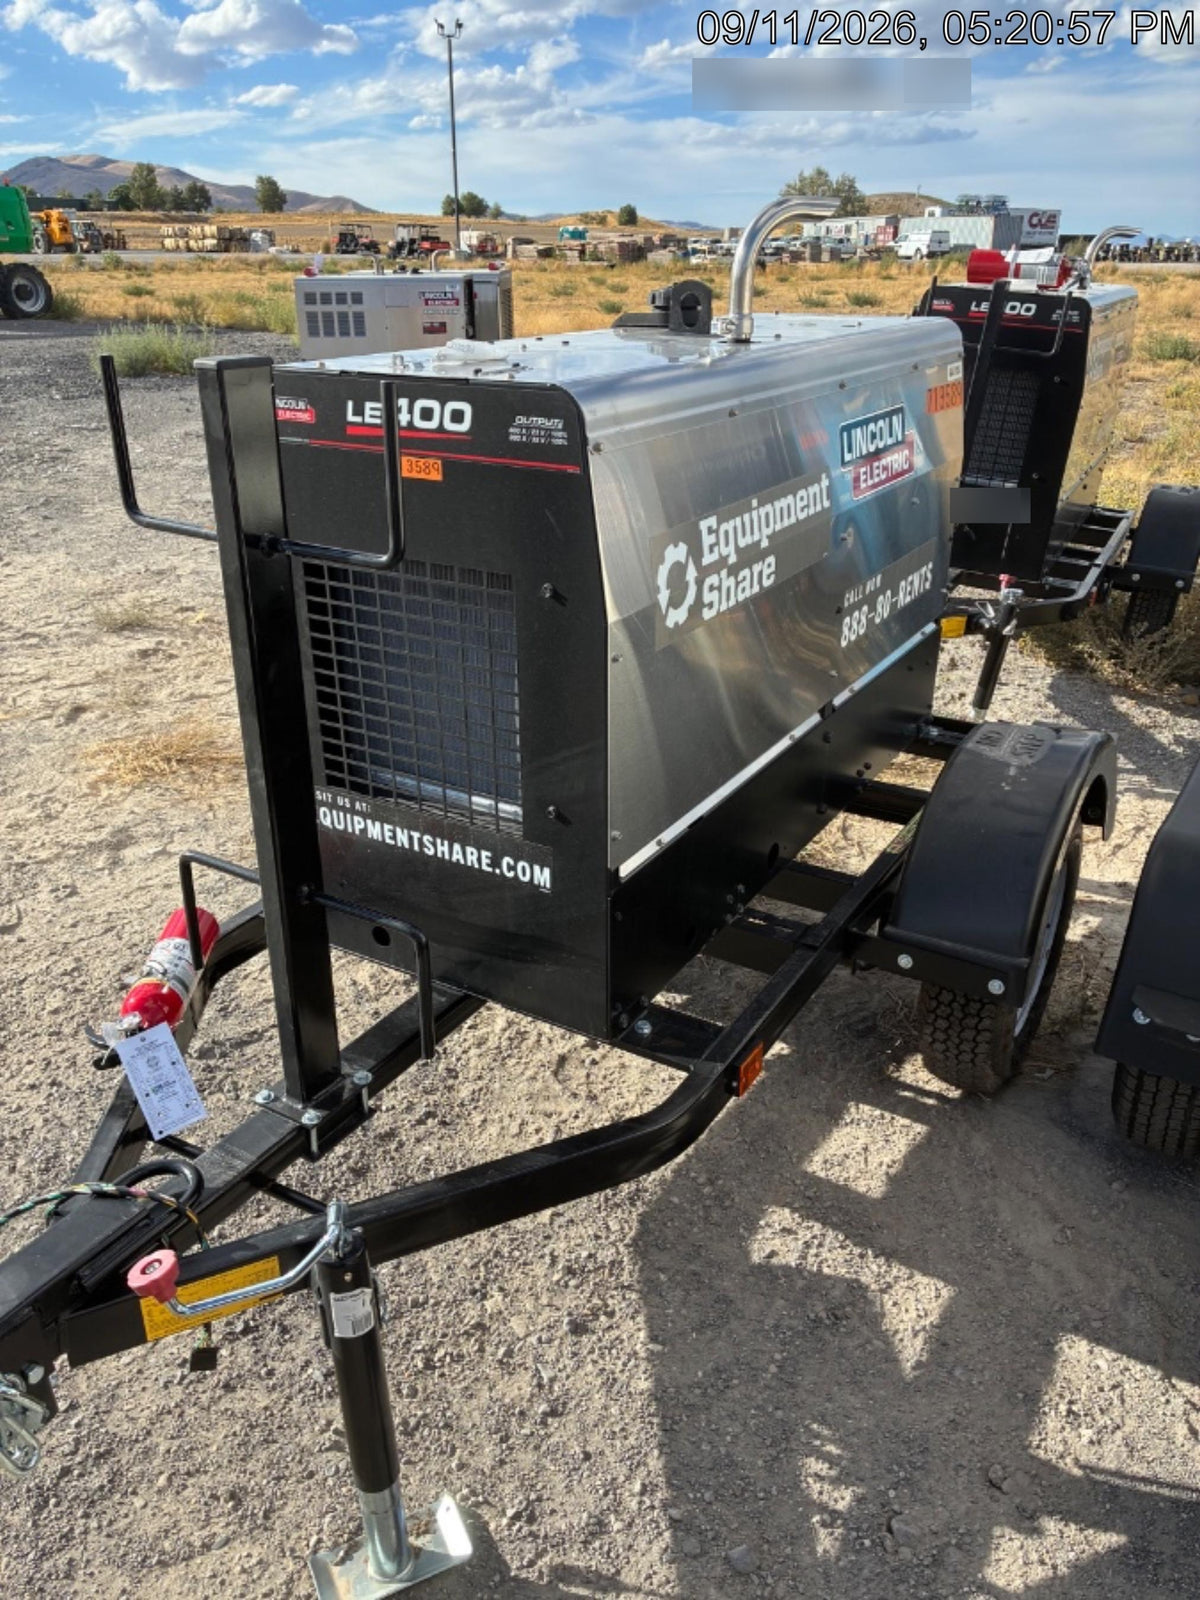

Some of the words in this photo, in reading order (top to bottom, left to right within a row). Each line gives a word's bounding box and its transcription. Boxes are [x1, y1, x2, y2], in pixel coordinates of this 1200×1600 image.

[970, 301, 1037, 316] LE00
[842, 412, 903, 463] LINCOLN
[860, 449, 910, 490] ELECTRIC
[699, 473, 832, 566] Equipment
[702, 554, 777, 621] Share
[841, 561, 934, 648] 888-80-RENTS
[314, 790, 333, 803] SIT
[337, 796, 350, 808] US
[317, 806, 551, 889] QUIPMENTSHARE.COM
